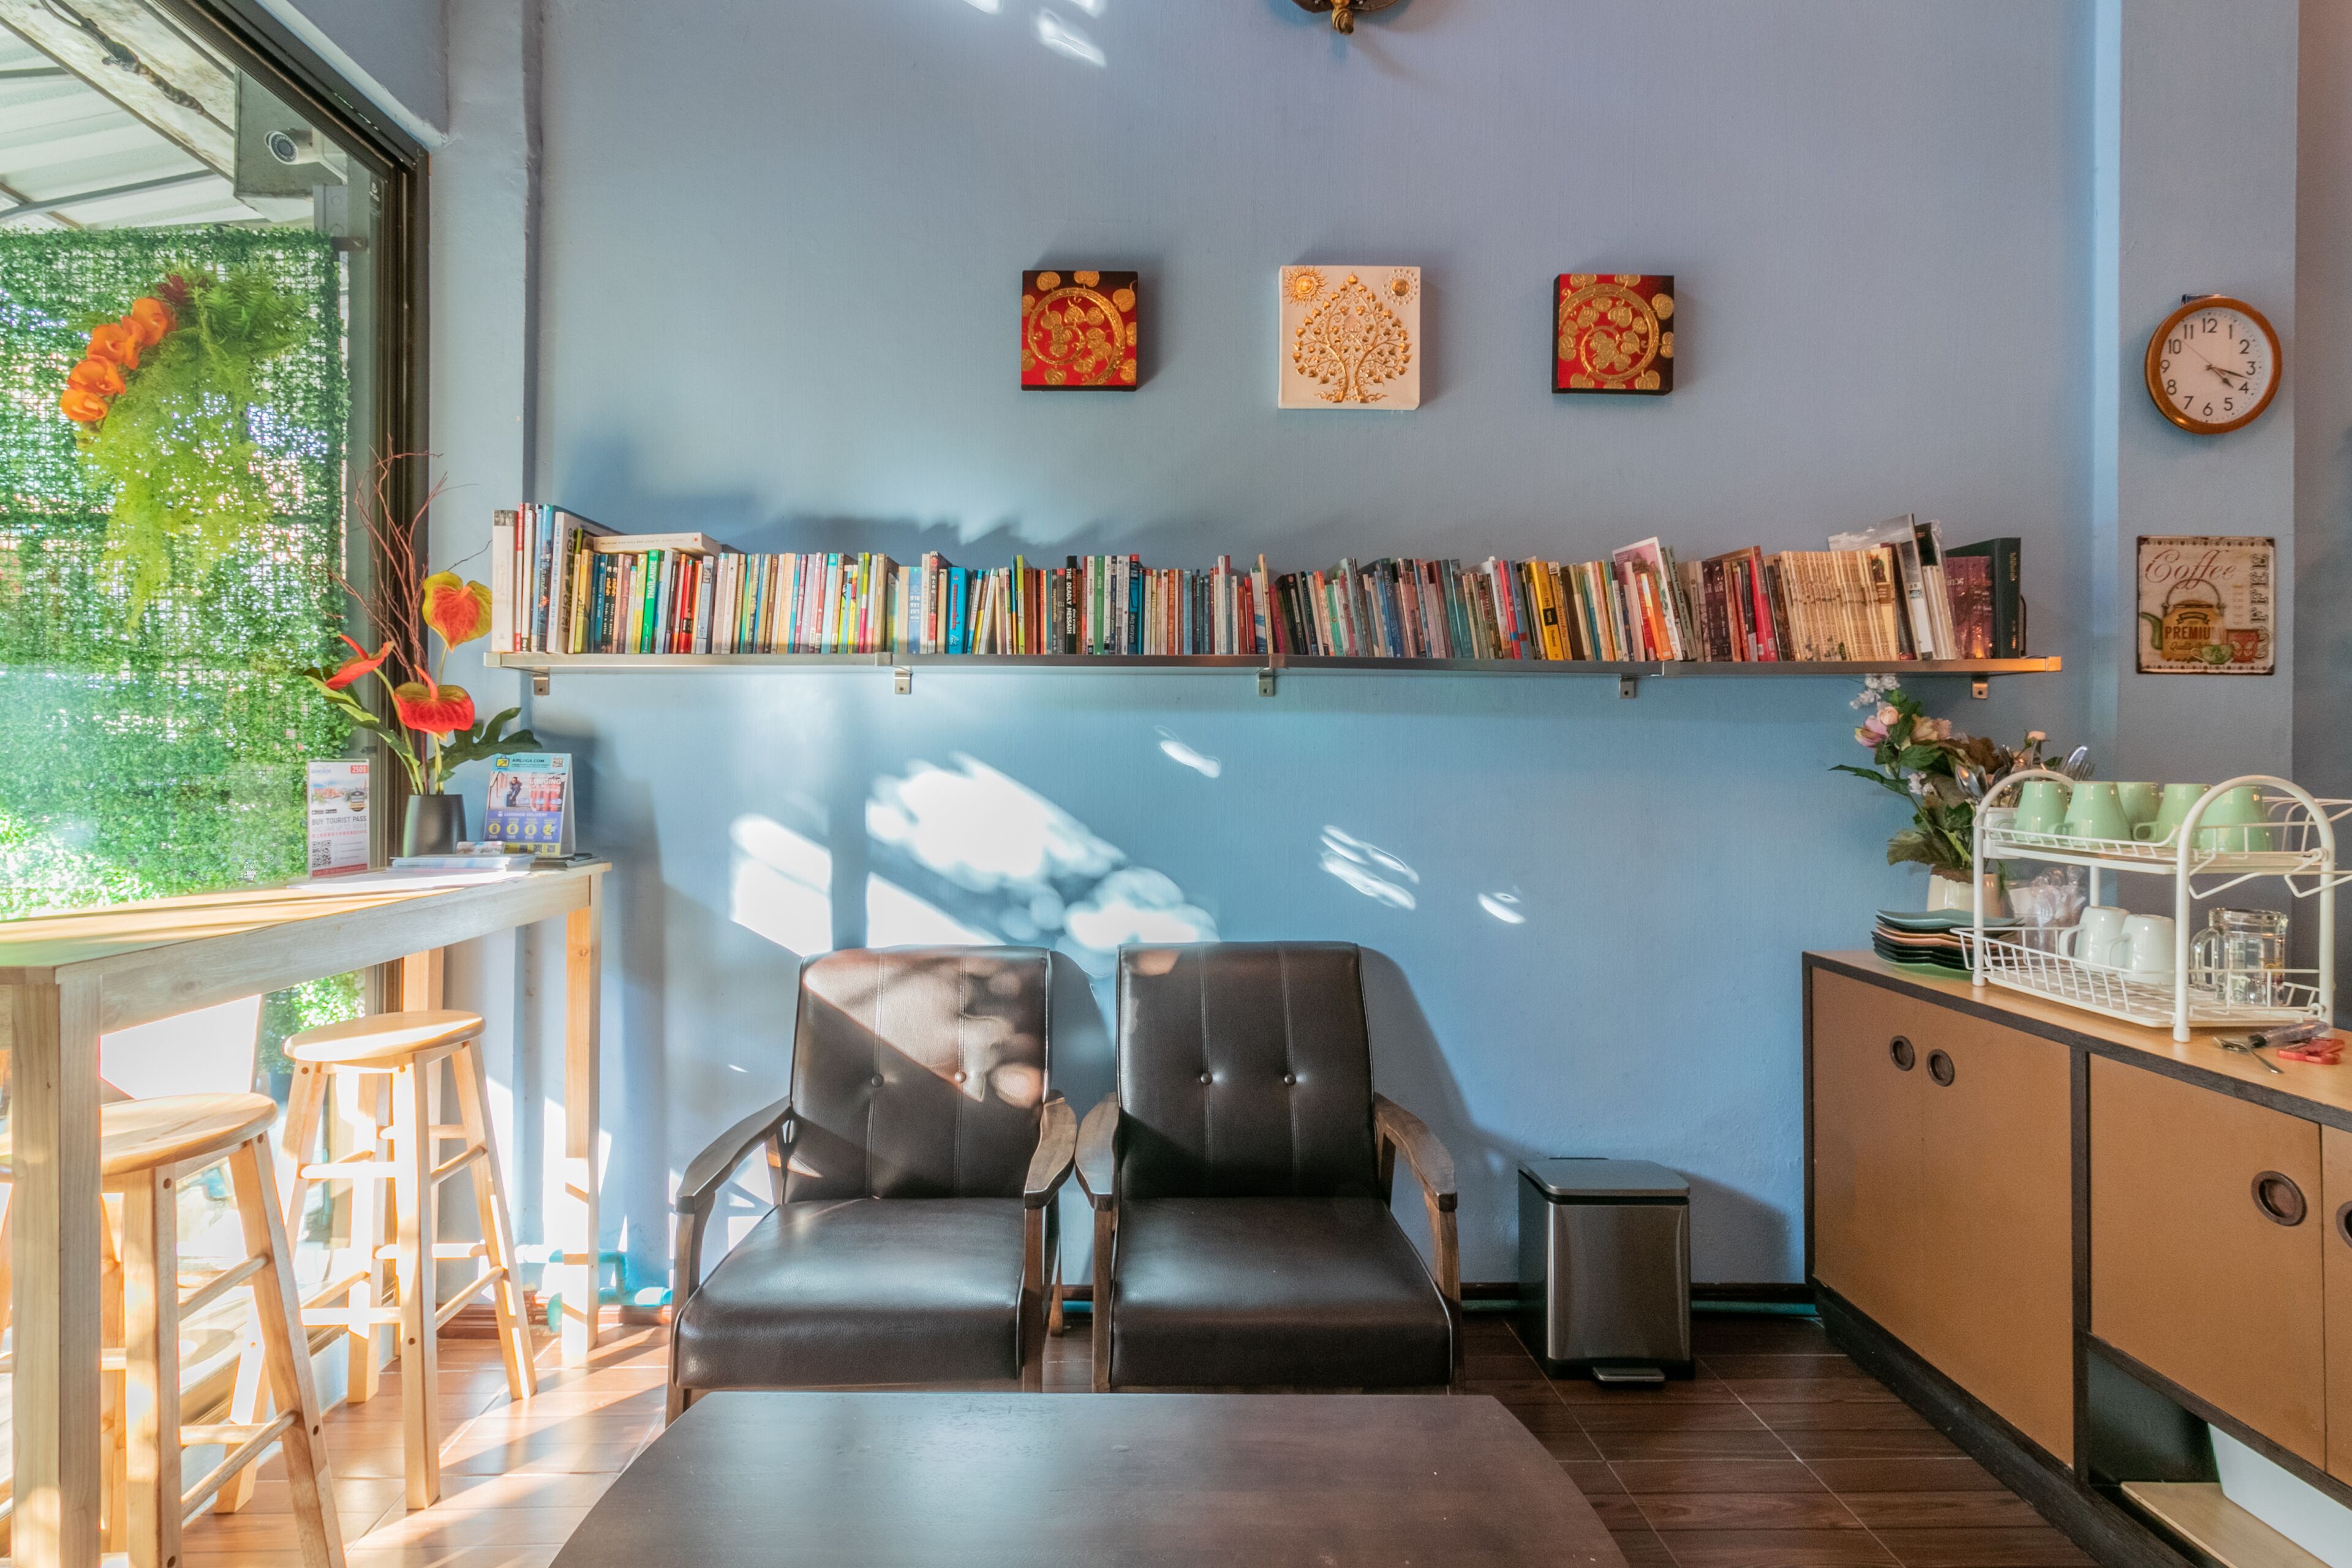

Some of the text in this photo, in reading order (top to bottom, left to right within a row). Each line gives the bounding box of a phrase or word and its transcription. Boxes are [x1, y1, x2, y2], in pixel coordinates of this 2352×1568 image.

[2184, 324, 2194, 339] 11
[2202, 318, 2218, 333] 12
[2229, 324, 2233, 339] 1
[2168, 339, 2181, 355] 10
[2239, 339, 2250, 355] 2
[2160, 360, 2170, 374] 9
[2246, 361, 2256, 375] 3
[2166, 379, 2177, 395] 8
[2238, 382, 2249, 394] 4
[2184, 396, 2194, 410] 7
[2203, 402, 2213, 416] 6
[2223, 398, 2233, 411] 5
[2145, 549, 2236, 589] Coffee
[2164, 625, 2215, 640] PREMIU
